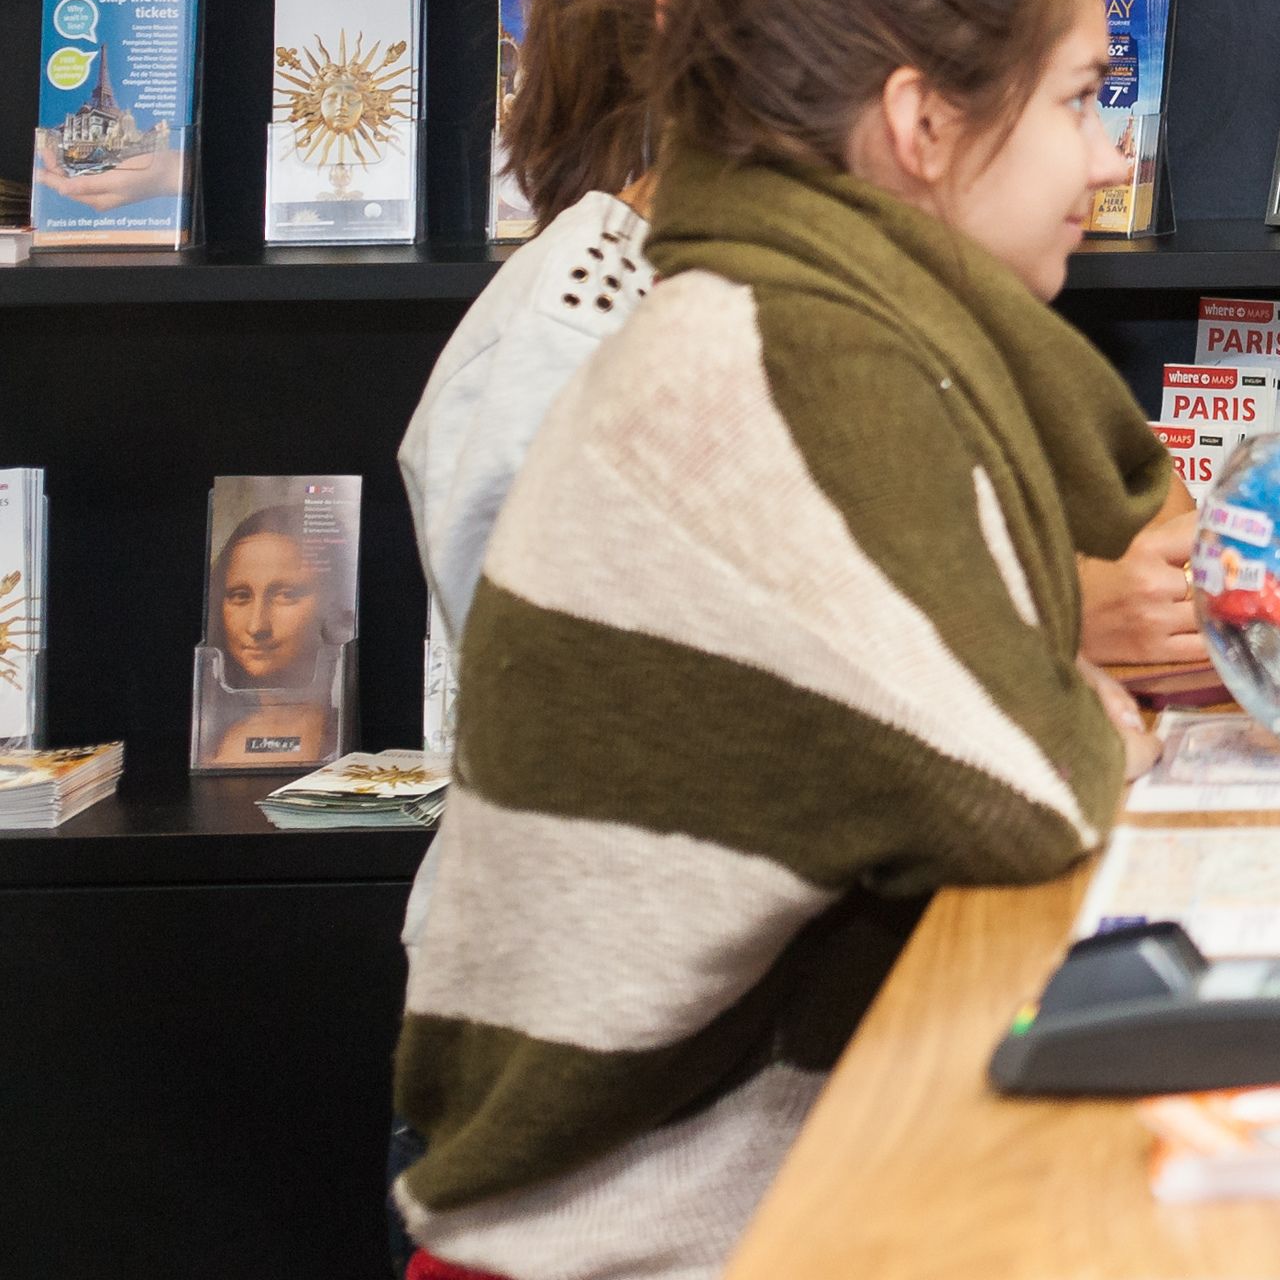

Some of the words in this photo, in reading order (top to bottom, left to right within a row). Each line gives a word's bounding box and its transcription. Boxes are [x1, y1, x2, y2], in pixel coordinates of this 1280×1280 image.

[135, 7, 179, 19] tickets
[1106, 0, 1134, 18] AY
[46, 219, 67, 227] Paris
[68, 219, 76, 227] in
[78, 218, 92, 227] the
[93, 218, 116, 229] palm
[117, 217, 127, 226] of
[127, 219, 147, 228] your
[148, 217, 171, 227] hand
[1204, 304, 1235, 317] where
[1247, 306, 1271, 318] MAPS
[1168, 371, 1201, 384] where
[1211, 374, 1235, 385] MAPS
[1173, 395, 1256, 422] PARIS
[1169, 433, 1192, 444] MAPS
[1171, 456, 1213, 482] RIS
